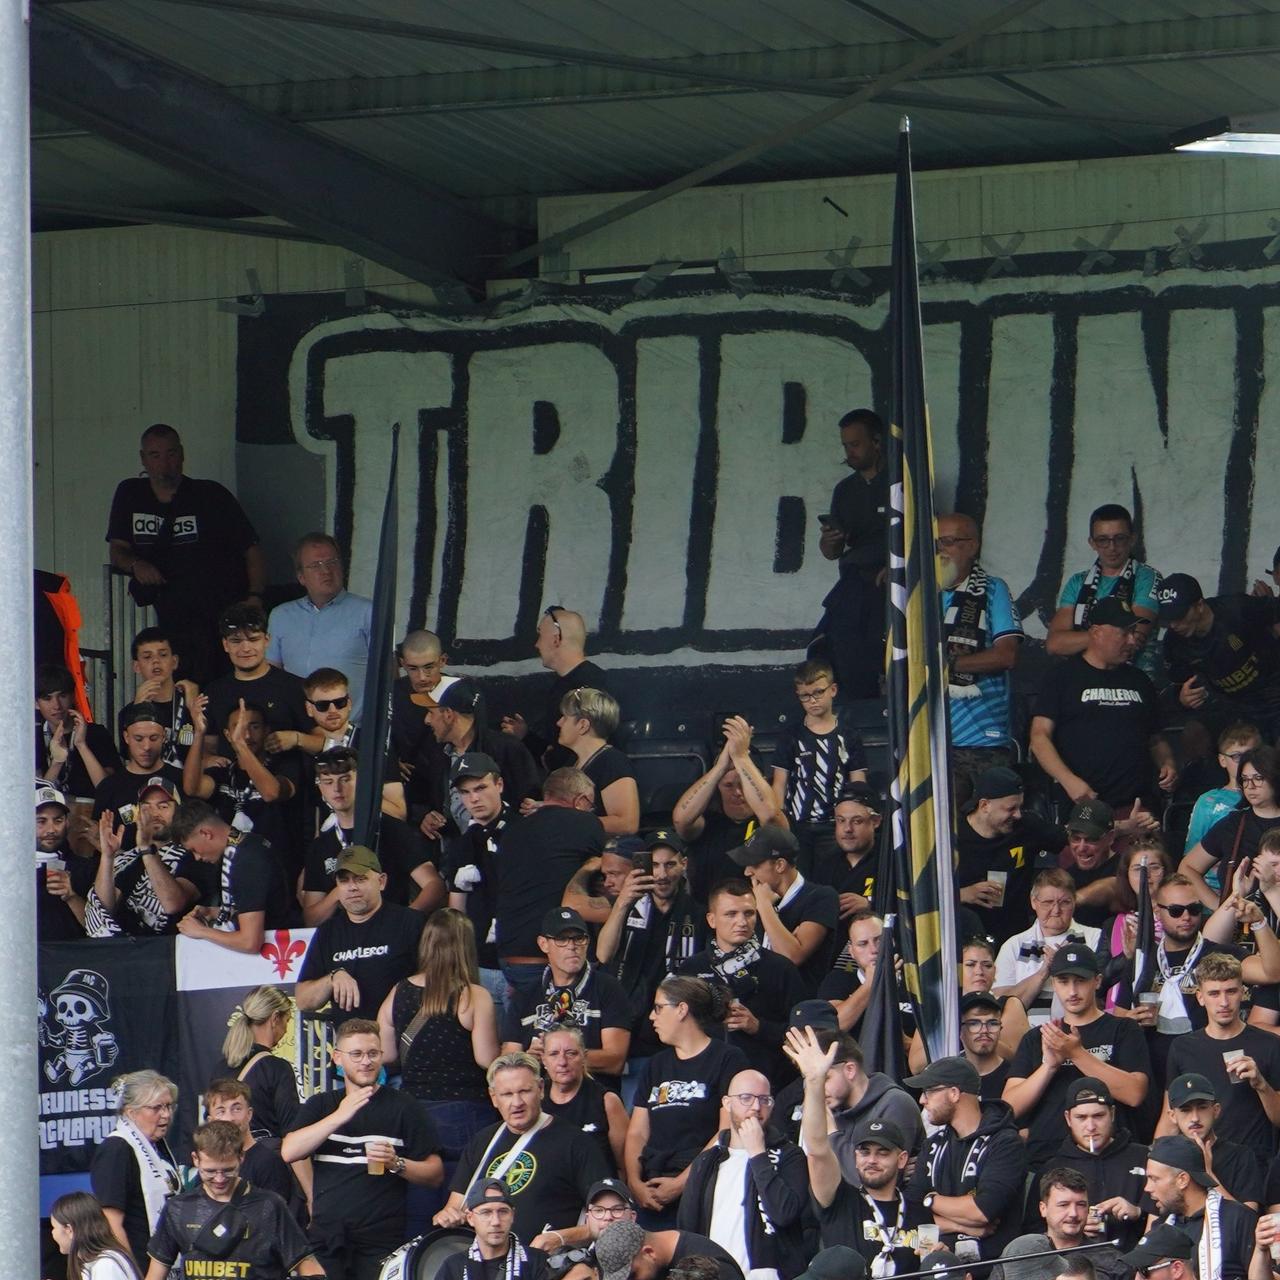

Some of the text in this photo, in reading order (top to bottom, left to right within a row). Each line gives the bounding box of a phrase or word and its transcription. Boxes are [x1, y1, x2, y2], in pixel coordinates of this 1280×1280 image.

[134, 513, 196, 536] adias
[1214, 655, 1258, 691] NIBET
[1081, 688, 1143, 703] CHARLEROI
[332, 944, 390, 962] CHARLEROI
[40, 1089, 121, 1115] EUNESS
[184, 1260, 252, 1280] UNIBET
